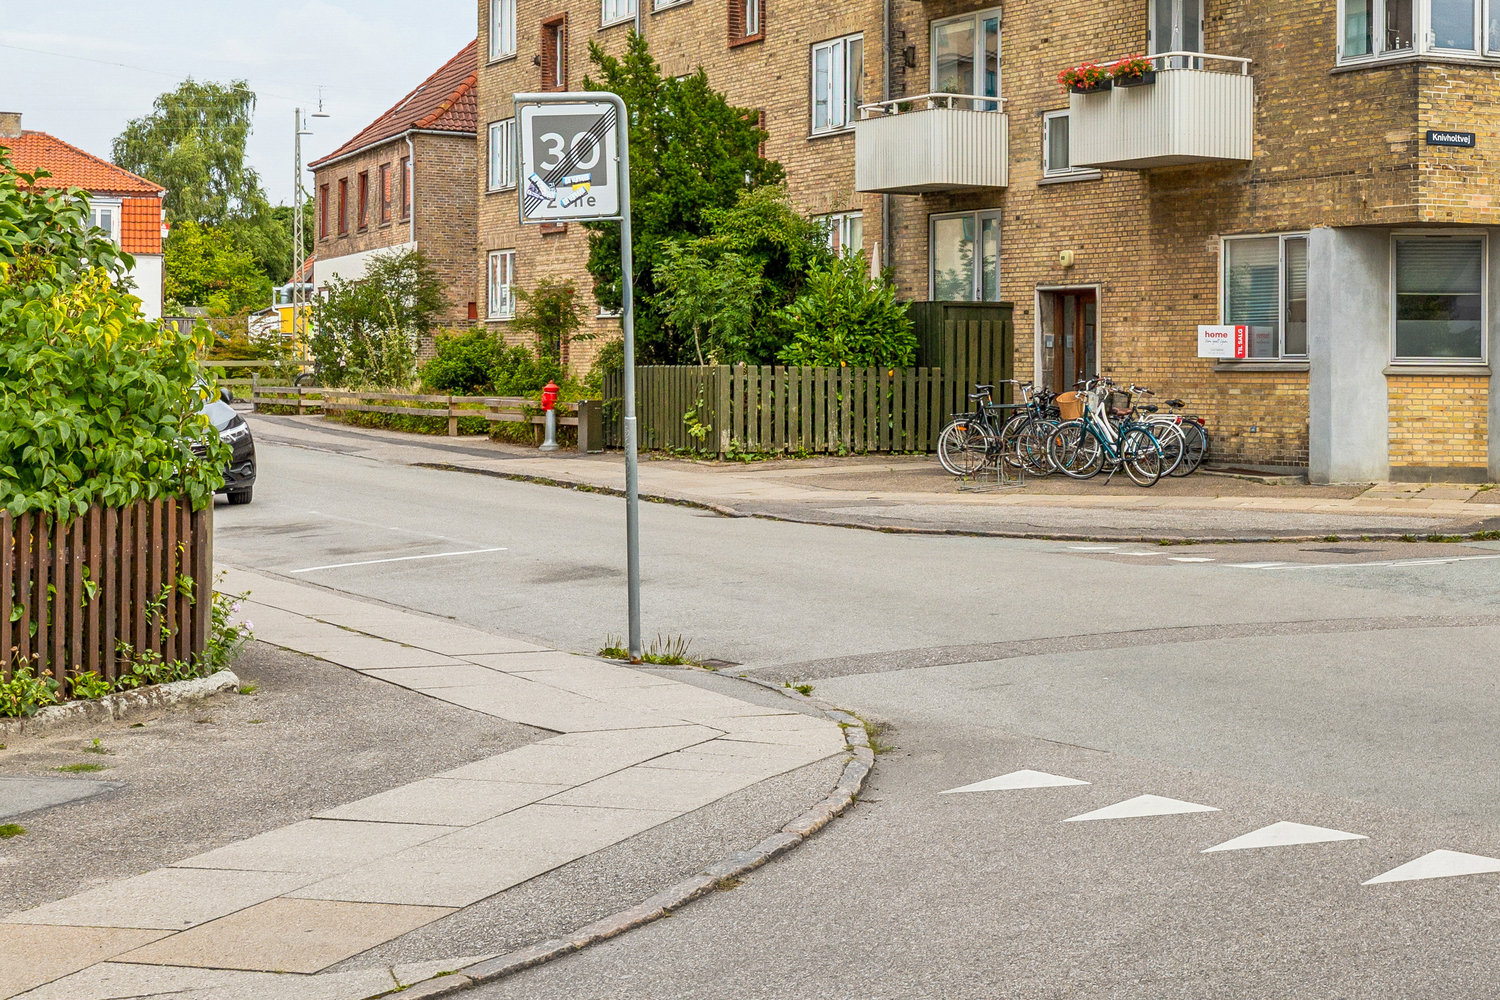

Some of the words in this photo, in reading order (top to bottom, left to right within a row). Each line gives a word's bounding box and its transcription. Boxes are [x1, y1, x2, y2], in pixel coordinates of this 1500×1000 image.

[1432, 133, 1470, 144] Knivholtvej
[540, 131, 601, 171] 30
[1204, 330, 1228, 338] home
